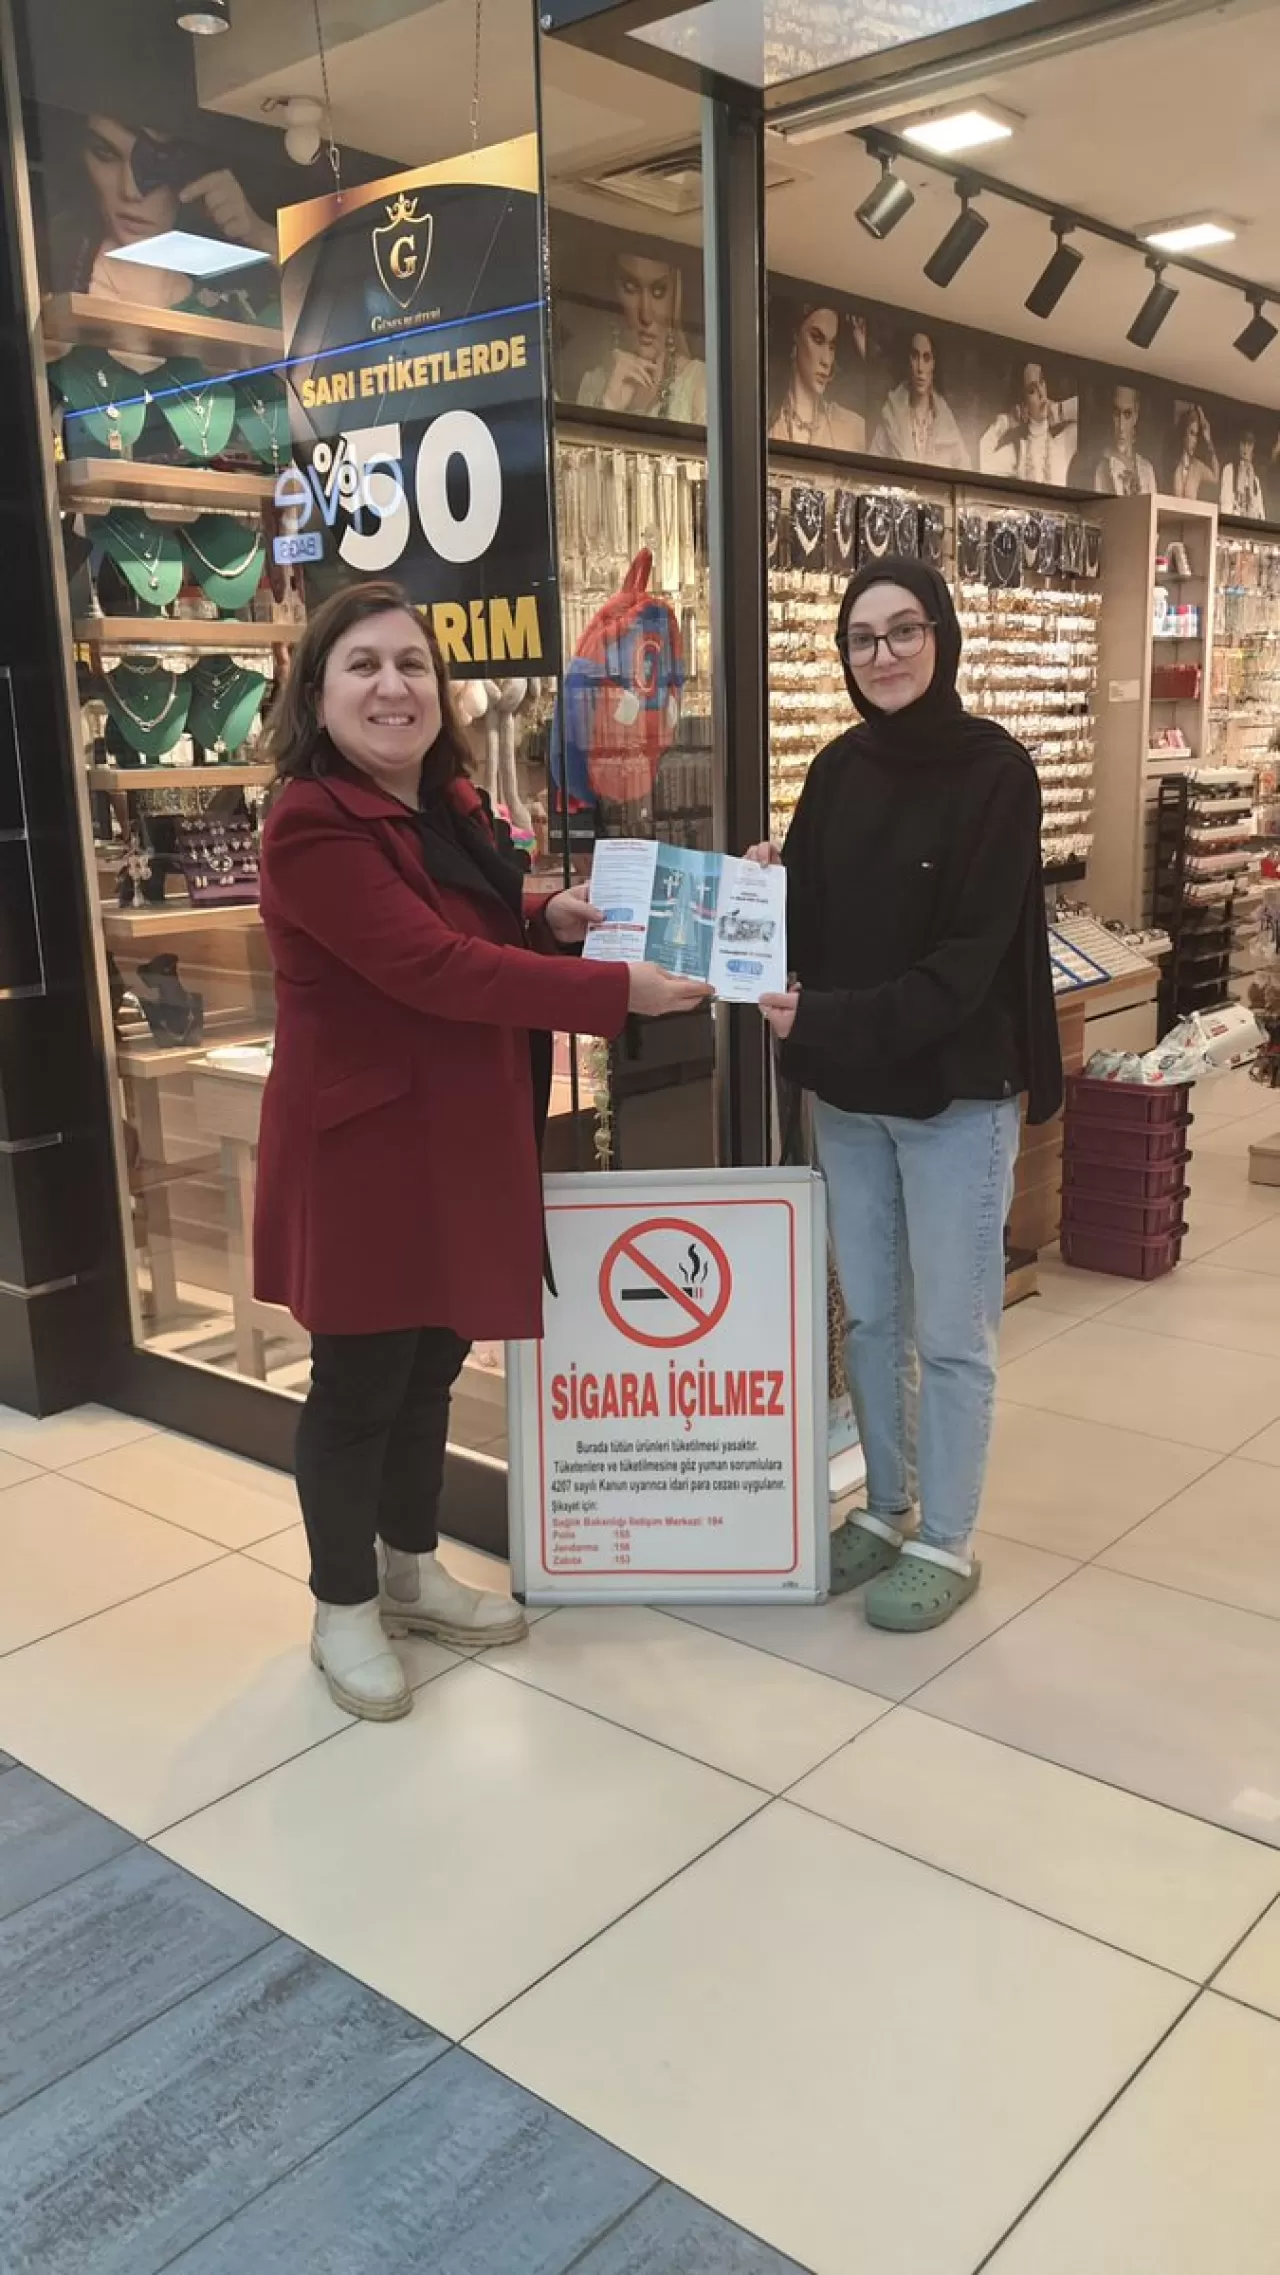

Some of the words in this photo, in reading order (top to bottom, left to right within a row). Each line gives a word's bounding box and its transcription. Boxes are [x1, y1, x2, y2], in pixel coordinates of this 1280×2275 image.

[390, 234, 418, 279] G
[302, 371, 355, 409] SARI
[360, 335, 527, 398] ETİKETLERDE
[415, 595, 544, 664] RİM
[551, 1362, 660, 1421] SİGARA
[669, 1358, 785, 1432] İÇİLMEZ
[576, 1440, 608, 1454] Burada
[610, 1439, 634, 1453] tütün
[635, 1438, 670, 1453] ürünleri
[671, 1438, 720, 1452] tüketilmesi
[606, 1462, 617, 1472] ve
[619, 1459, 678, 1472] tüketilmesine
[680, 1459, 696, 1475] göz
[698, 1461, 728, 1474] yuman
[729, 1458, 782, 1471] sorumlulara
[551, 1479, 572, 1492] 4207
[599, 1479, 628, 1491] Kanun
[691, 1480, 710, 1493] para
[712, 1479, 740, 1491] cezası
